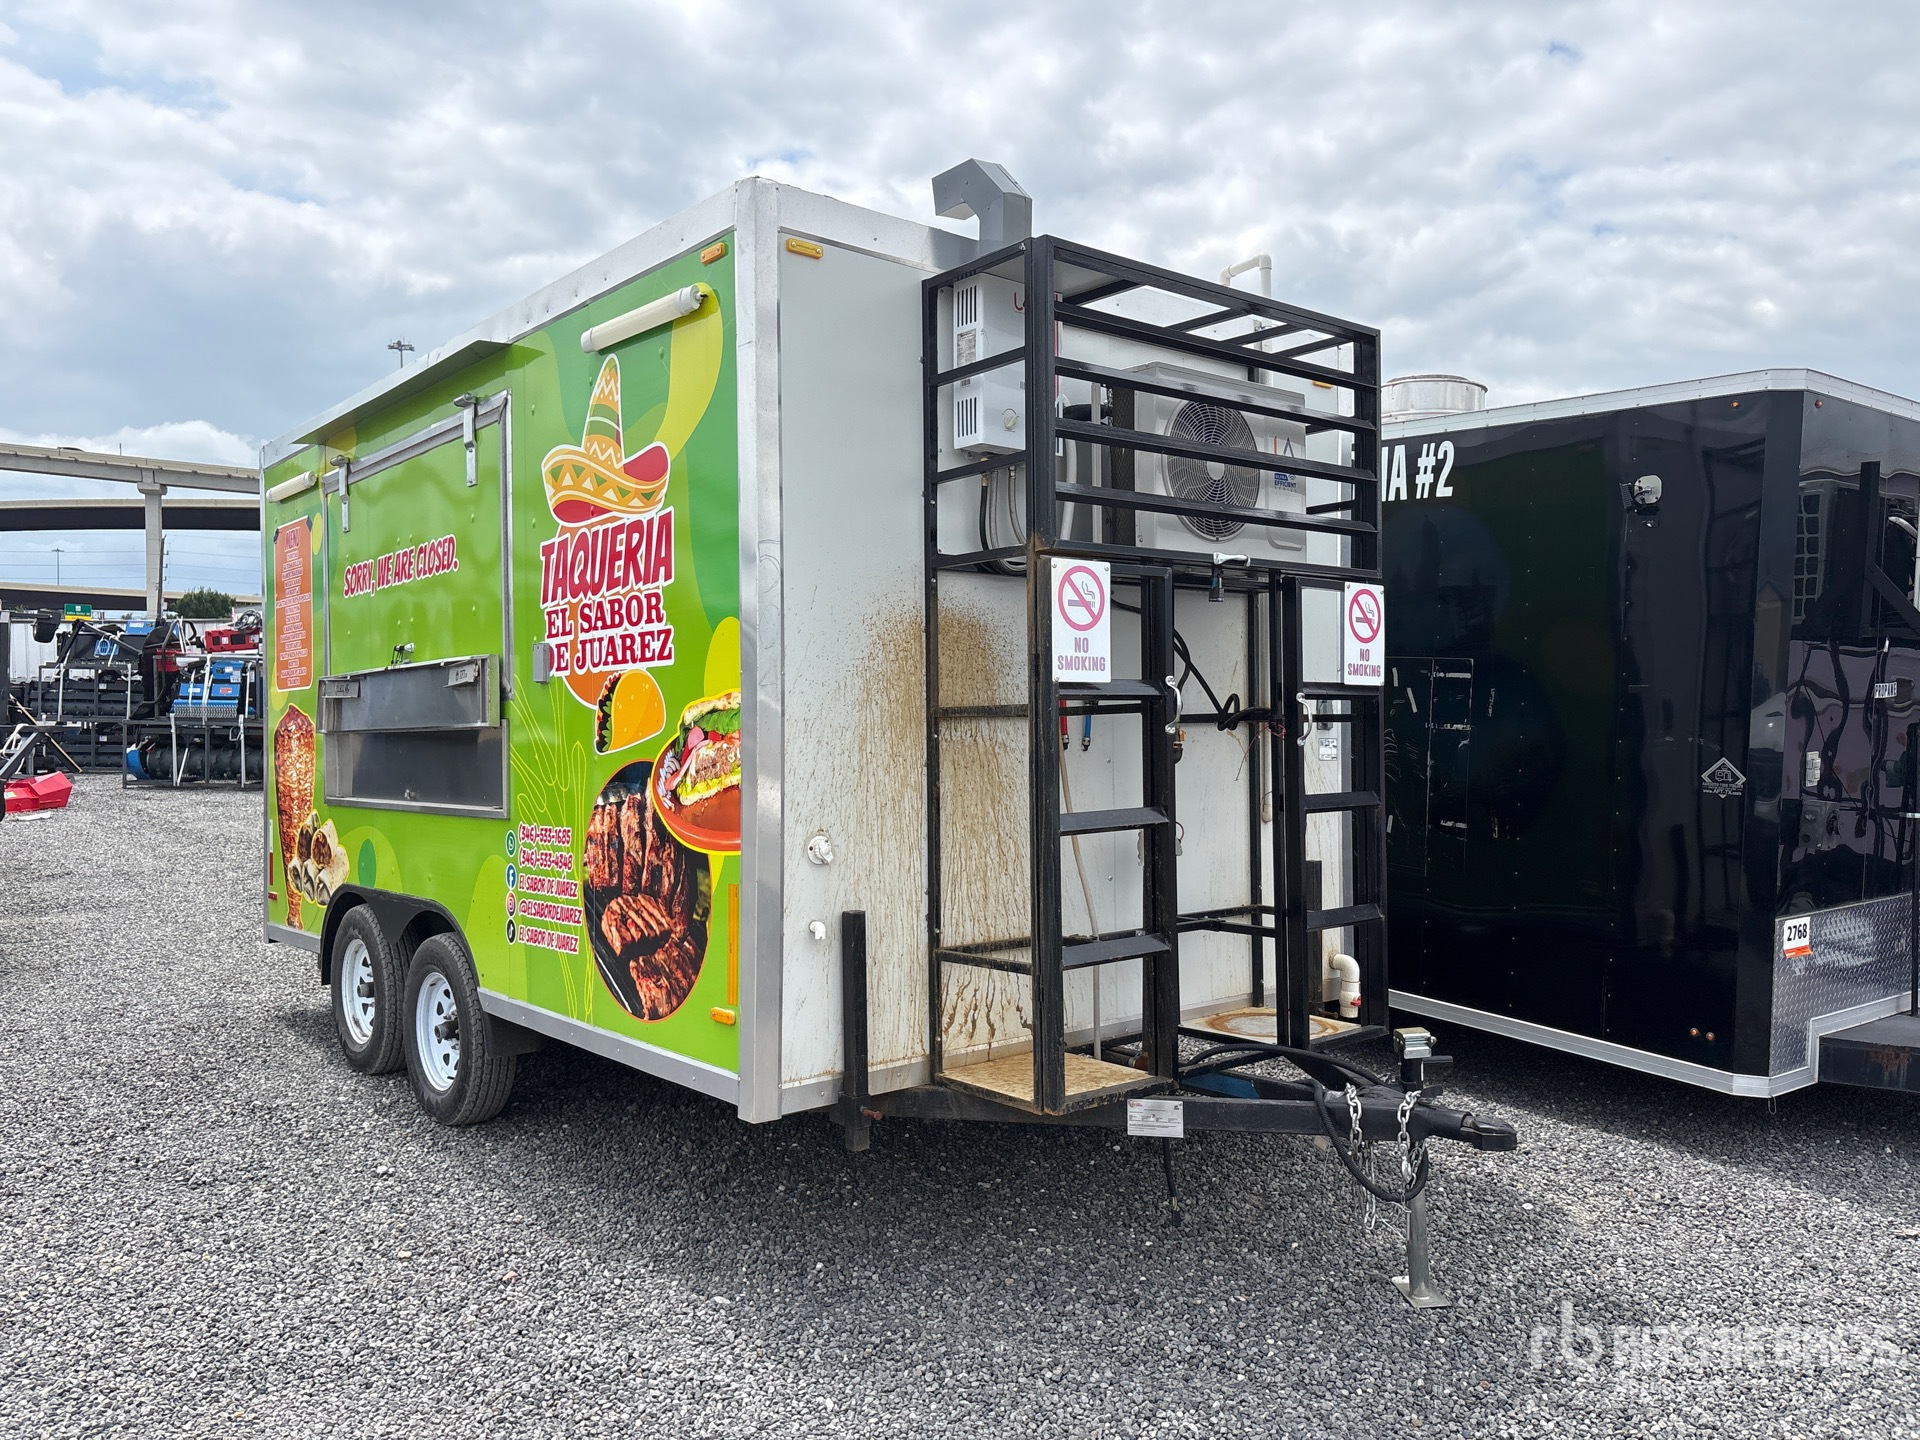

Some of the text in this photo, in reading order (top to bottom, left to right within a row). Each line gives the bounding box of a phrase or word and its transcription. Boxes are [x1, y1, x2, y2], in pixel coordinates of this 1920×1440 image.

[1415, 440, 1455, 499] #2
[1274, 480, 1297, 488] EFFICIENT
[284, 526, 301, 551] MENU
[344, 535, 459, 597] SORRY, WE ARE CLOSED.
[541, 510, 673, 605] TAQUERIA
[546, 592, 665, 640] EL SABOR
[576, 628, 673, 670] JUAREZ
[1074, 637, 1089, 654] NO
[1359, 648, 1370, 662] NO
[1057, 655, 1106, 672] SMOKING
[1347, 663, 1381, 678] SMOKING
[1875, 682, 1897, 698] PROPANE
[518, 823, 571, 846] (346)-533-1685
[518, 847, 573, 871] (346)-533-4348
[519, 874, 525, 890] EL
[526, 876, 546, 893] SABOR
[547, 878, 555, 895] DE
[518, 899, 583, 925] @ELSABORDEJUAREZ
[519, 926, 579, 953] EL SABOR DE JUAREZ
[1786, 923, 1808, 942] 2768
